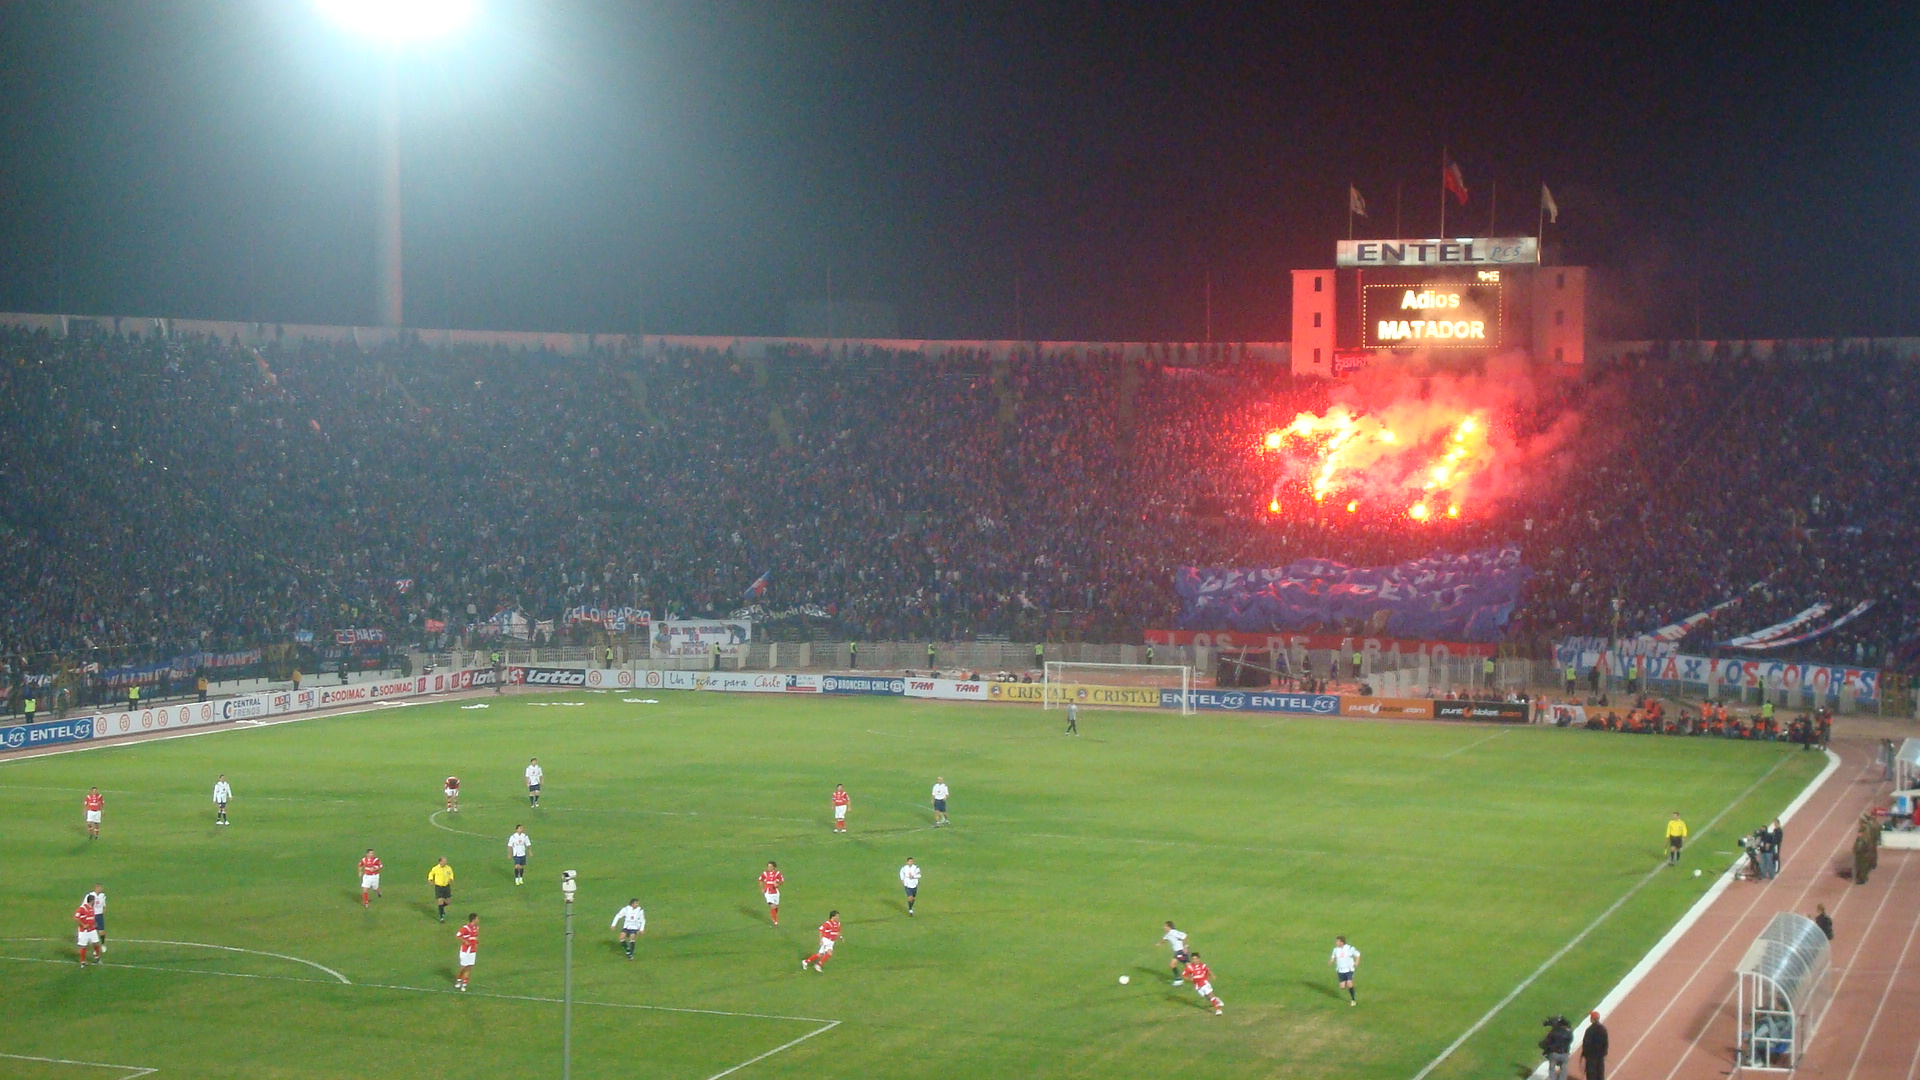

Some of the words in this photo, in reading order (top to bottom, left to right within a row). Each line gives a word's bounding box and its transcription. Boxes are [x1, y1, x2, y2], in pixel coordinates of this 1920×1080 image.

[1357, 243, 1484, 262] ENTEL
[1491, 245, 1522, 259] PCS
[1401, 290, 1460, 309] Adios
[1378, 320, 1485, 339] MATADOR
[1619, 654, 1679, 680] VIDA
[379, 682, 413, 696] SODIMAC
[670, 673, 684, 685] Un
[690, 673, 719, 686] techo
[724, 679, 748, 691] para
[872, 680, 889, 691] CHILE
[910, 681, 935, 691] TAM
[955, 684, 980, 693] TAM
[330, 688, 366, 702] SODIMAC
[1007, 686, 1071, 700] CRISTAL
[1093, 689, 1158, 703] CRISTAL
[1162, 693, 1221, 705] ENTEL
[1222, 696, 1245, 706] PCS
[233, 698, 261, 708] CENTRAL
[1251, 696, 1312, 708] ENTEL
[1313, 699, 1336, 710] PCS
[8, 731, 25, 743] PCS
[30, 727, 73, 741] ENTEL
[74, 720, 91, 734] PCS
